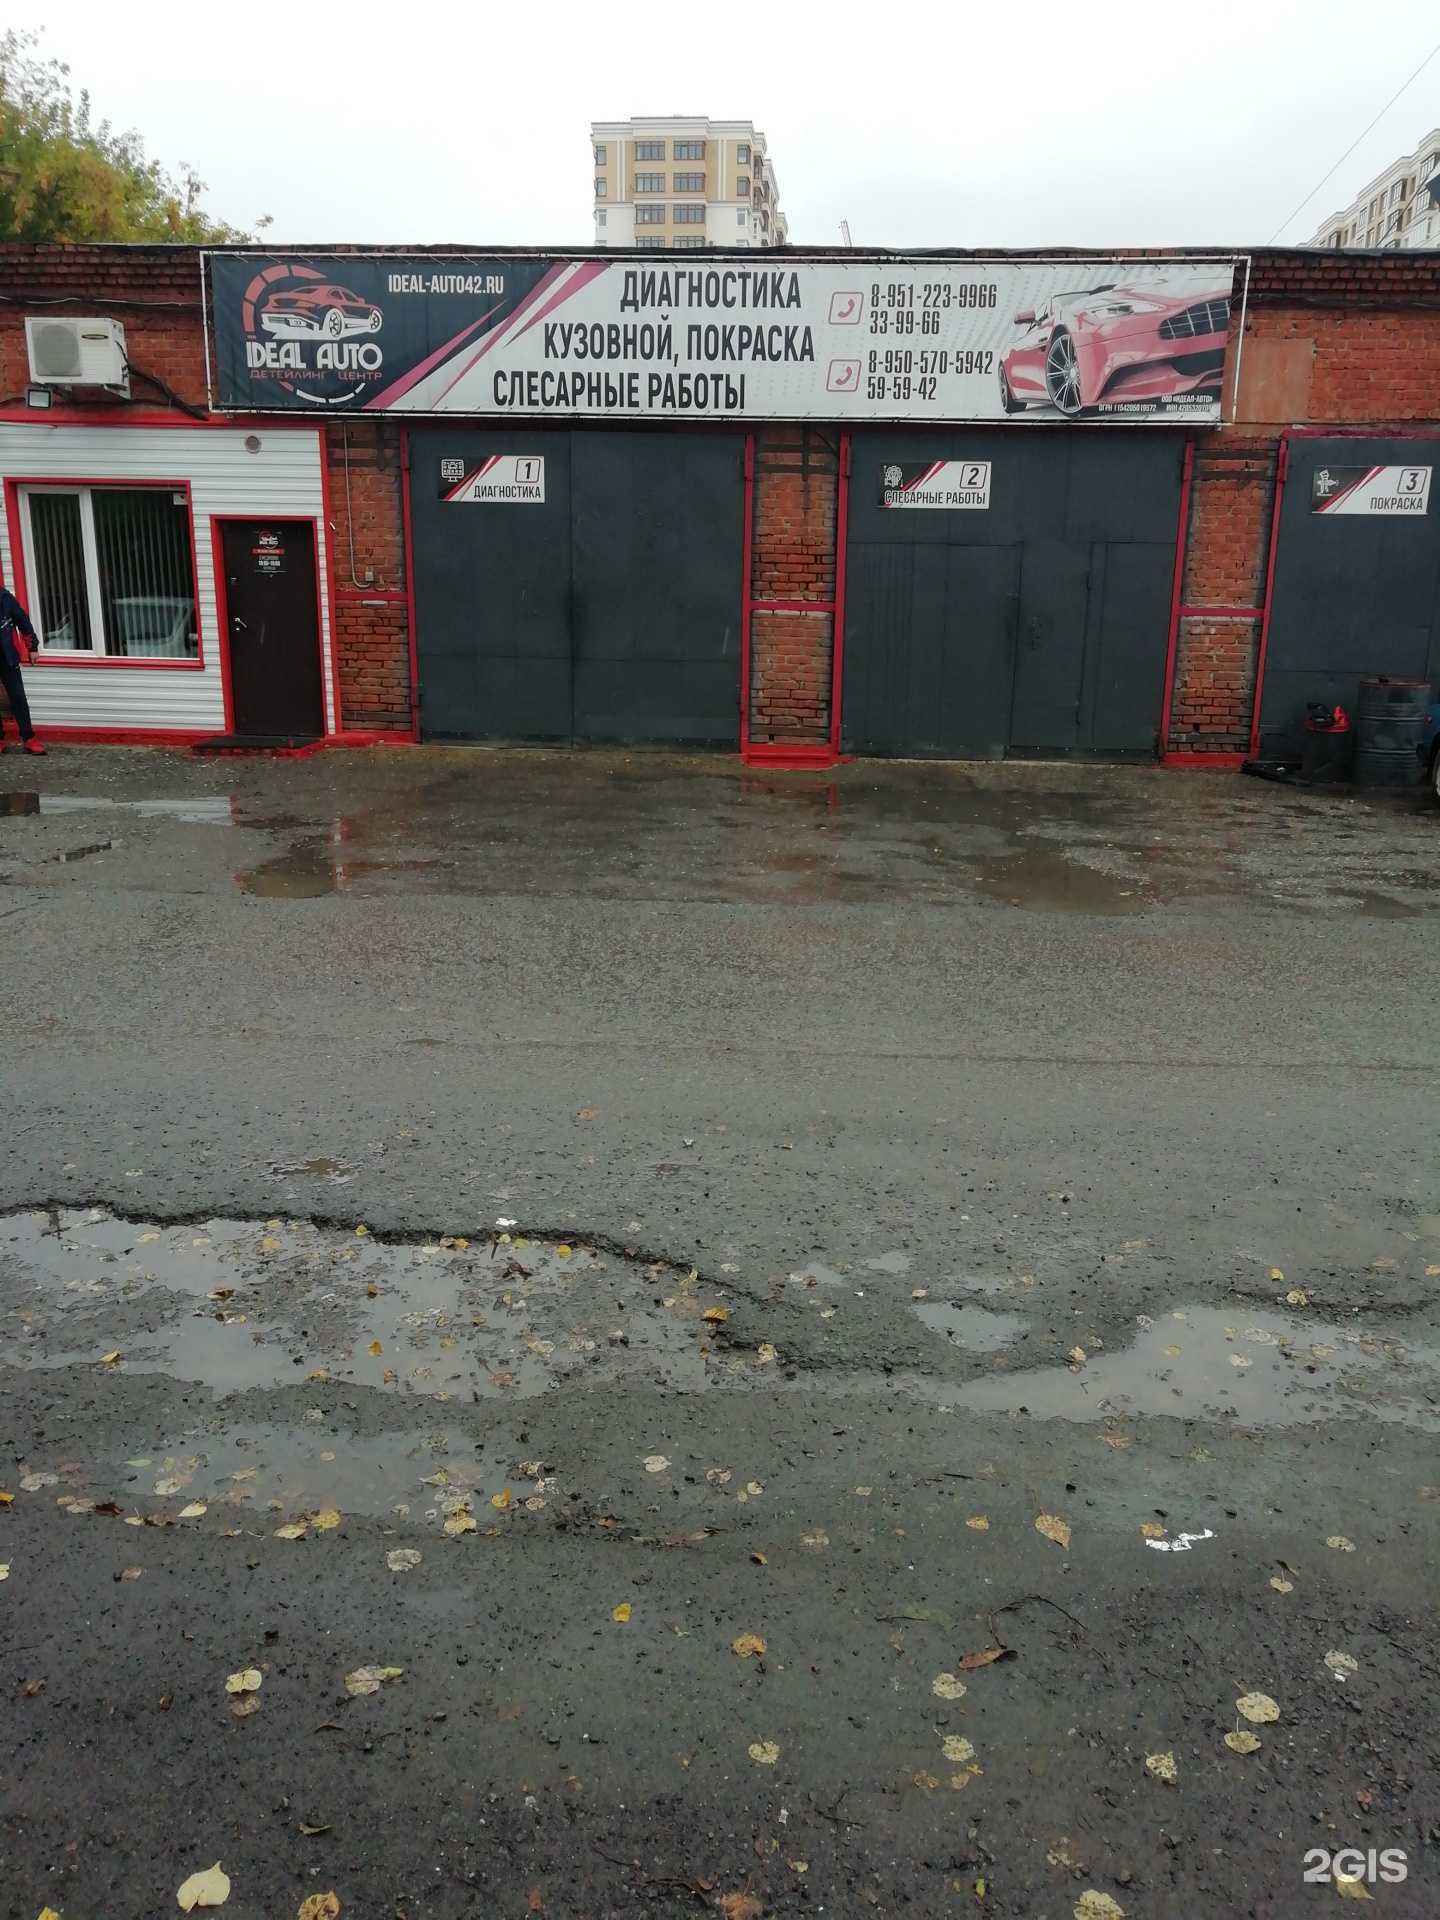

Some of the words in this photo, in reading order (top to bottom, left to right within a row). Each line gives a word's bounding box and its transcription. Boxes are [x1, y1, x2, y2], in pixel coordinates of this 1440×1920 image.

[388, 274, 504, 294] IDEAL-AUTO42.RU
[620, 271, 801, 312] ДИАГНОСТИКА
[871, 284, 997, 308] 8-951-223-9966
[870, 311, 940, 334] 33-99-66
[544, 314, 679, 367] КУЗОВНОЙ,
[687, 325, 815, 362] ПОКРАСКА
[245, 341, 307, 369] IDEAL
[316, 342, 383, 370] AUTO
[868, 350, 993, 374] 8-950-570-5942
[250, 369, 326, 380] ДЕТЕЙЛИНГ
[337, 371, 382, 382] ЦЕНТР
[493, 370, 640, 407] СЛЕСАРНЫЕ
[648, 372, 745, 409] РАБОТЫ
[867, 377, 937, 400] 59-59-42
[524, 461, 533, 480] 1
[966, 467, 980, 486] 2
[473, 485, 541, 499] ДИАГНОСТИКА
[1405, 472, 1419, 491] 3
[884, 490, 944, 504] СЛЕСАРНЫЕ
[946, 492, 986, 505] РАБОТЫ
[1370, 496, 1423, 510] ПОКРАСКА
